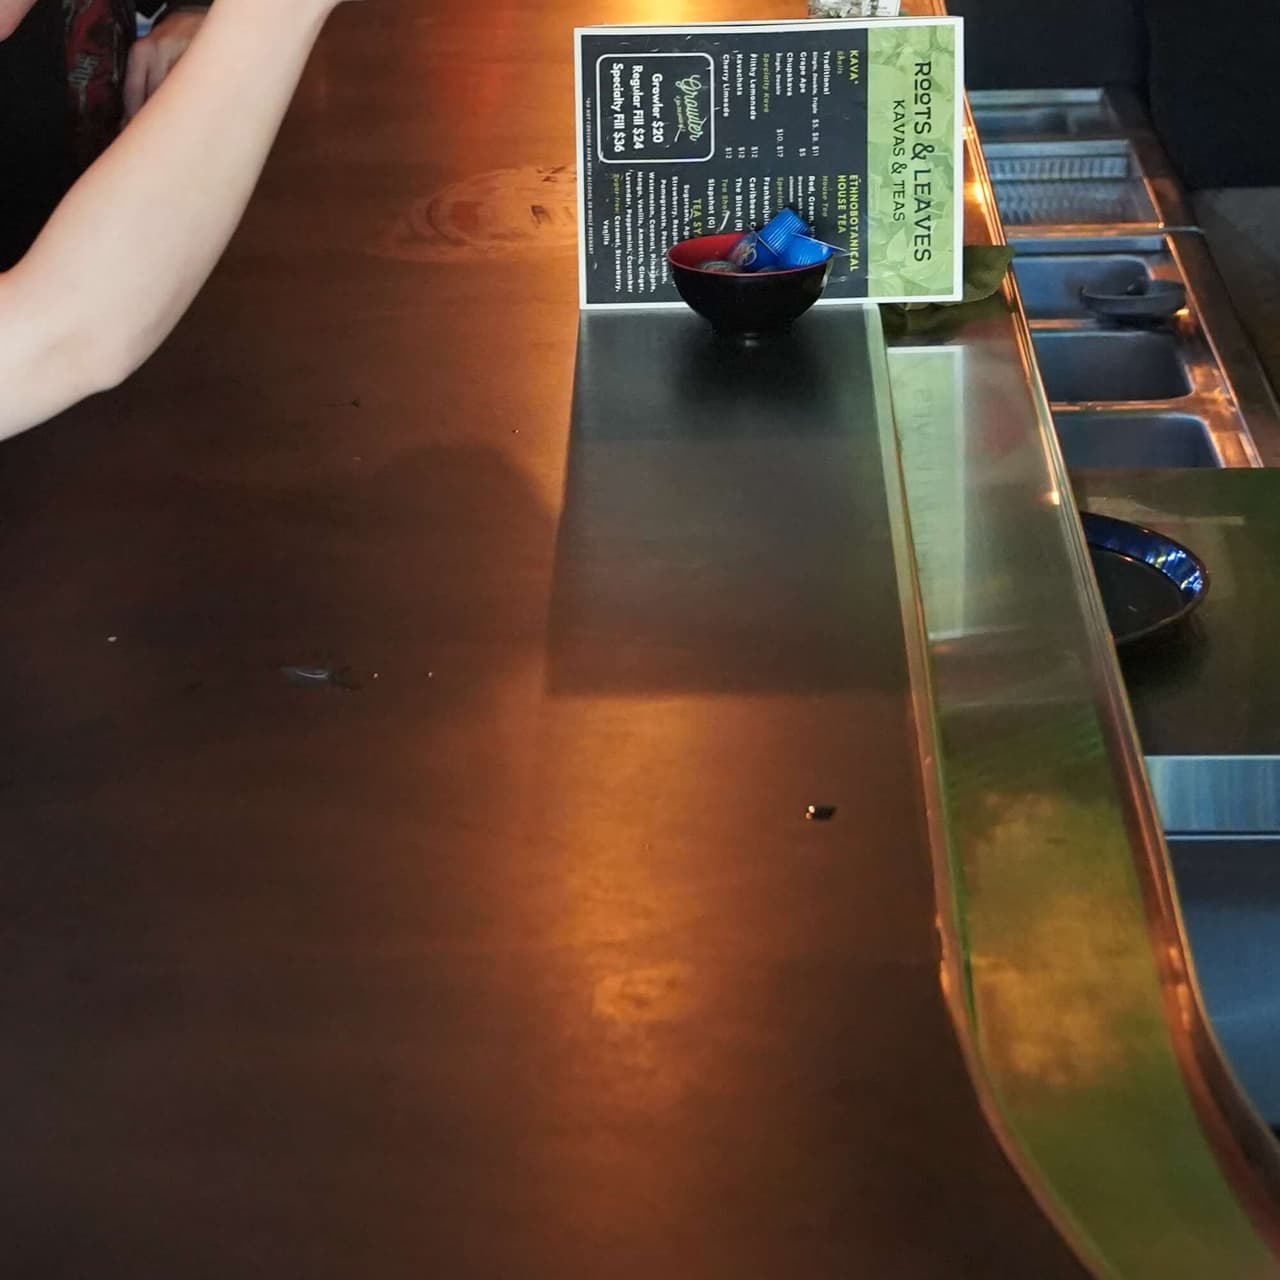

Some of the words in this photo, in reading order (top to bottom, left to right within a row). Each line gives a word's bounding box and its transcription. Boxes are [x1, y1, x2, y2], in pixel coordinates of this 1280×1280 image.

[722, 54, 731, 81] Cherry
[736, 53, 744, 96] Kavachata
[748, 53, 759, 77] Filthy
[762, 52, 771, 91] Specialty
[785, 51, 794, 97] Chupakava
[799, 51, 807, 76] Grape
[823, 51, 831, 95] Traditional
[610, 62, 625, 112] Specialty
[629, 65, 645, 108] Regular
[651, 73, 664, 119] Growler
[722, 83, 731, 117] Limeade
[750, 79, 758, 120] Lemonade
[799, 77, 807, 93] Ape
[913, 61, 932, 135] ROOTS
[613, 113, 626, 129] Fill
[632, 109, 645, 126] Fill
[651, 120, 665, 144] $20
[892, 99, 906, 157] KAVAS
[613, 131, 626, 153] $36
[632, 127, 646, 150] $24
[725, 147, 733, 159] $12
[738, 146, 746, 159] $12
[751, 146, 759, 158] $12
[910, 142, 935, 161] &
[890, 161, 908, 175] &
[636, 171, 644, 198] Mango,
[648, 171, 656, 218] Watermelon,
[708, 178, 716, 215] Slapshot
[735, 177, 743, 193] The
[749, 176, 757, 220] Caribbean
[807, 175, 816, 195] Red,
[837, 174, 847, 211] HOUSE
[637, 199, 645, 227] Vanilla,
[660, 179, 668, 230] Pomegranate,
[683, 184, 691, 225] Sugarcane,
[692, 198, 702, 218] TEA
[735, 194, 743, 220] Bitch
[807, 196, 816, 224] Green,
[892, 179, 906, 222] TEAS
[913, 169, 932, 262] LEAVES
[602, 219, 611, 246] Vanilla
[614, 215, 622, 248] Caramel,
[625, 208, 633, 255] Peppermint,
[649, 219, 657, 252] Coconut,
[837, 214, 847, 234] TEA
[849, 174, 860, 272] ETHNOBOTANICAL
[637, 227, 645, 265] Amaretto,
[660, 230, 668, 256] Peach,
[638, 266, 646, 293] Ginger,
[650, 253, 658, 293] Pineapple,
